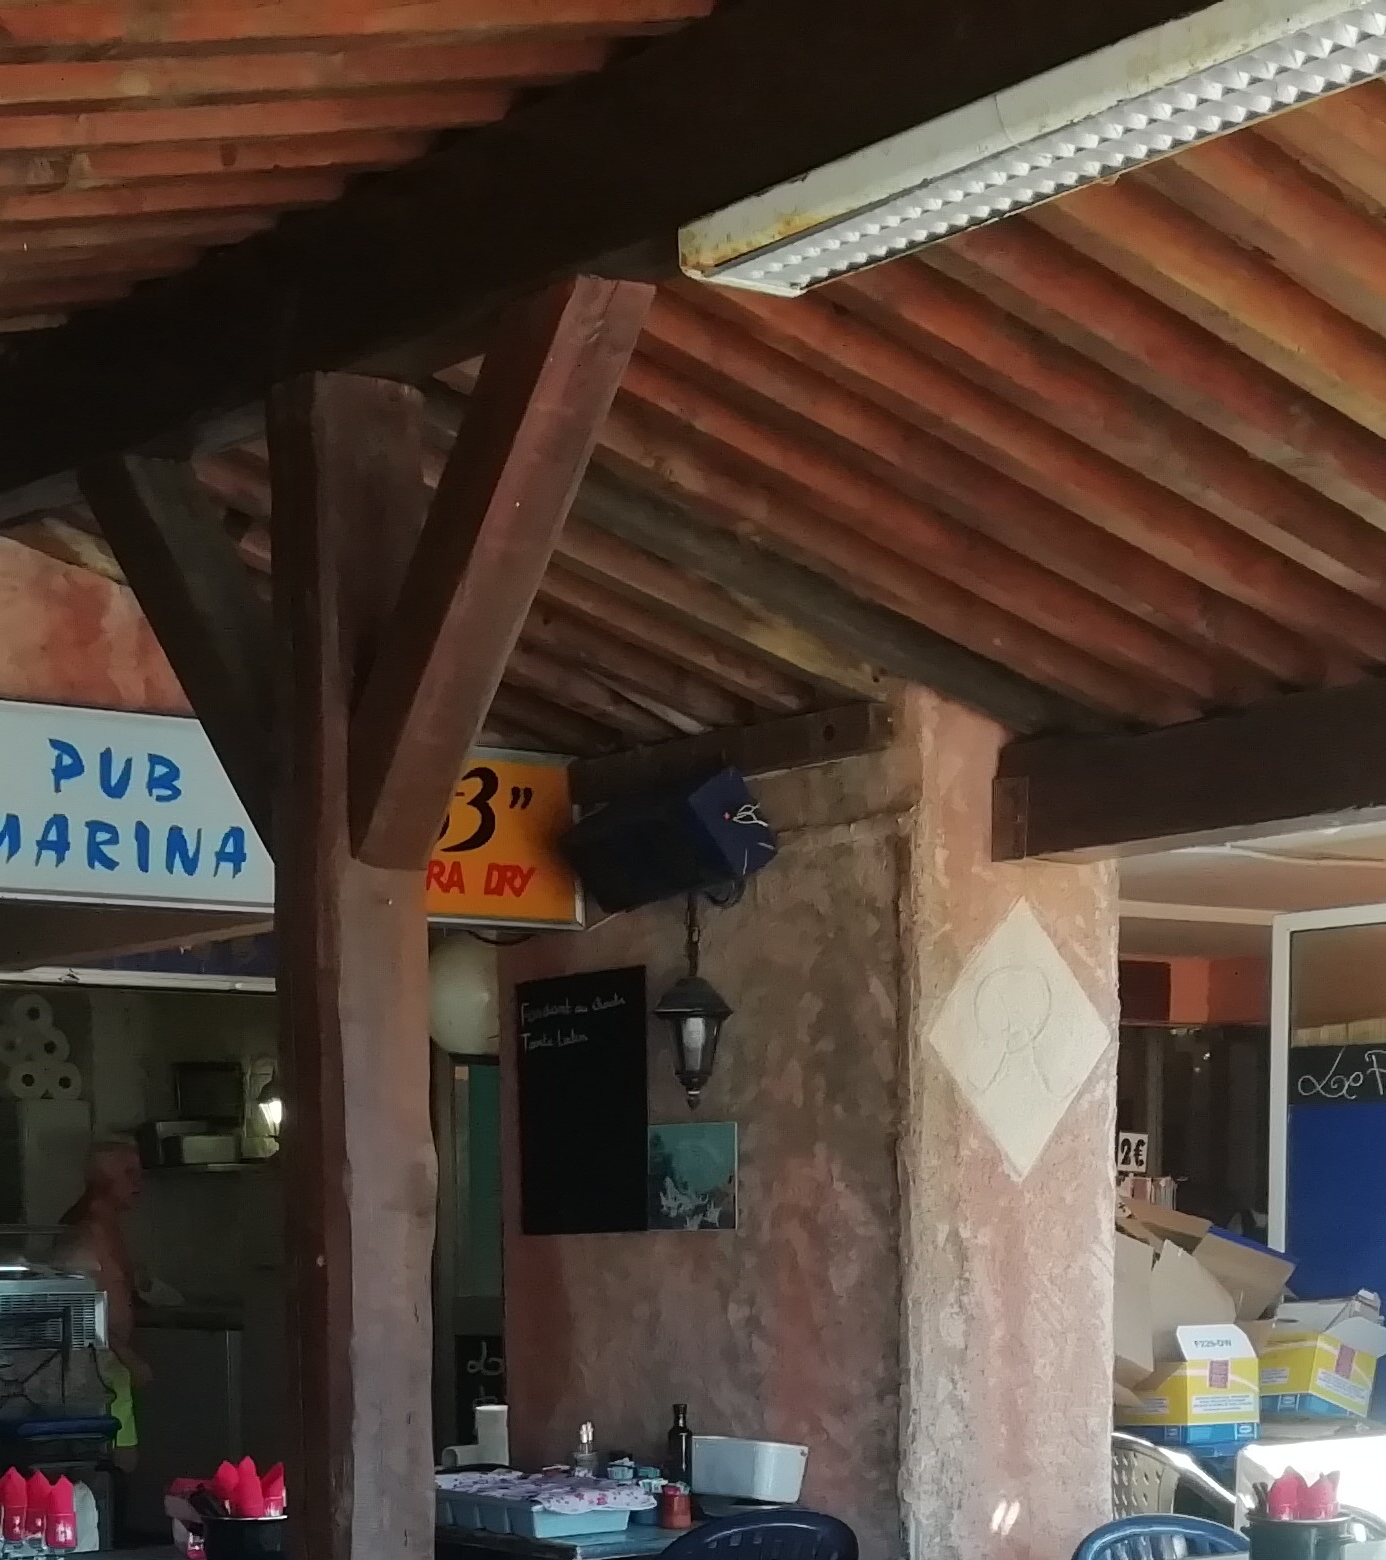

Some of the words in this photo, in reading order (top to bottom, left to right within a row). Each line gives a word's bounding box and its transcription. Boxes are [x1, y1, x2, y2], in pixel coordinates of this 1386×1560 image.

[48, 738, 181, 803] PUB
[484, 862, 536, 897] DRY
[1298, 1047, 1363, 1099] Le
[1120, 1138, 1146, 1167] 2€
